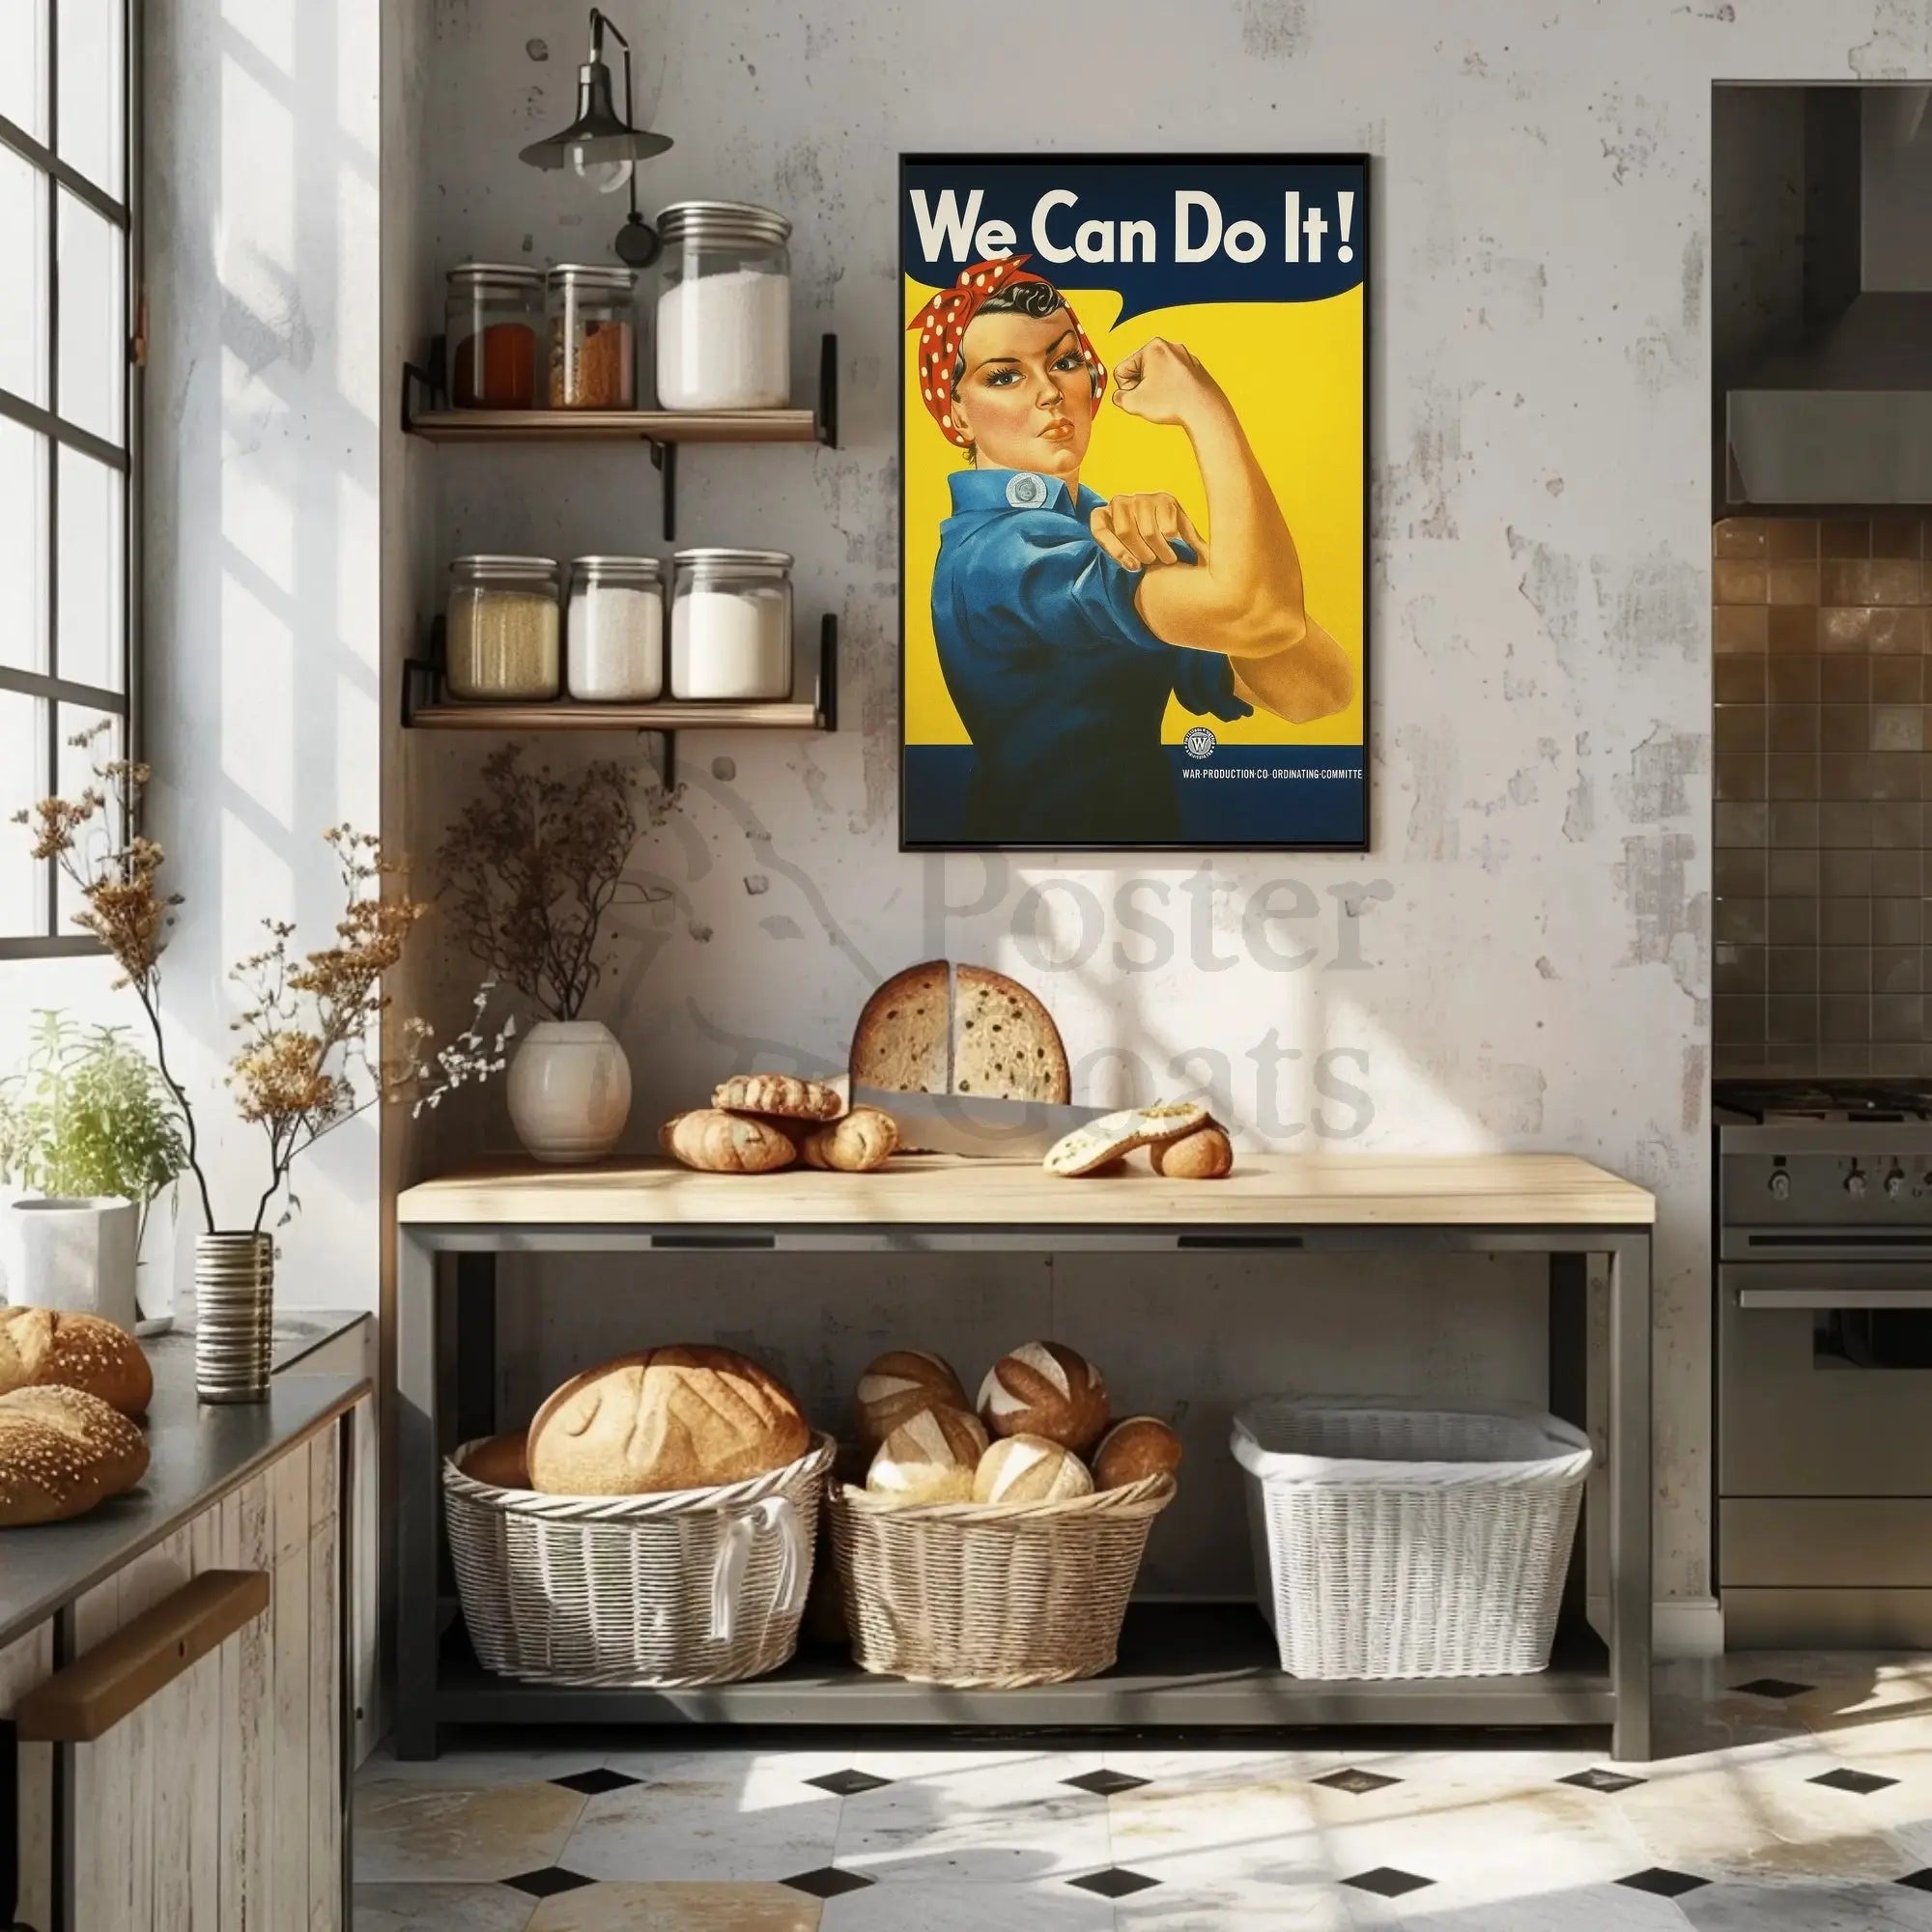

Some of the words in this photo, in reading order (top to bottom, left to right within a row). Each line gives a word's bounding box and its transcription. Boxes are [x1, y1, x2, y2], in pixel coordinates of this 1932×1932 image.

[909, 189, 1016, 263] We
[1031, 188, 1156, 263] Can
[1175, 190, 1266, 263] Do
[1285, 191, 1354, 263] It!
